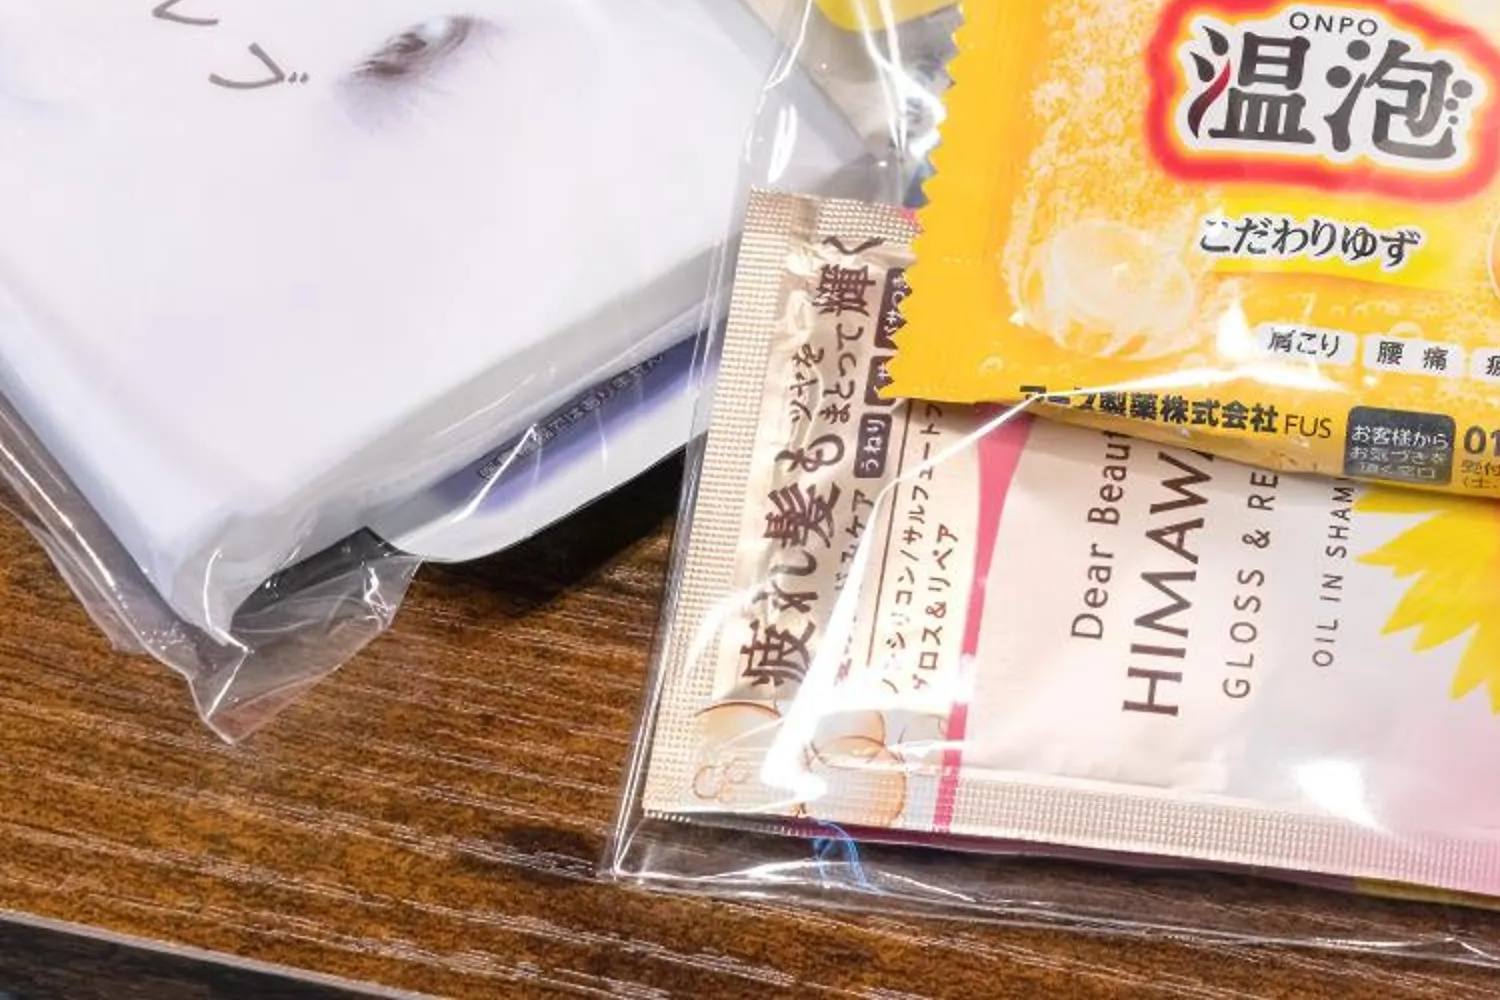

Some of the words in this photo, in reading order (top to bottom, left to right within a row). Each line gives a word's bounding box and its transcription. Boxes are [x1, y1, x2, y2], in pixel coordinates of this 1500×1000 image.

[1289, 11, 1378, 37] ONPO
[1186, 24, 1473, 160] 温泡
[1200, 217, 1422, 267] こだわりゆず
[1267, 329, 1341, 359] 肩こり
[857, 418, 886, 472] うねり
[1284, 414, 1332, 438] FUS
[1350, 424, 1450, 450] お客様から
[1247, 470, 1280, 511] RE
[1241, 528, 1271, 549] &
[1325, 476, 1356, 559] SHAM
[1071, 544, 1115, 640] Dear
[1320, 573, 1344, 602] IN
[1222, 568, 1266, 700] GLOSS
[1312, 618, 1339, 668] OIL
